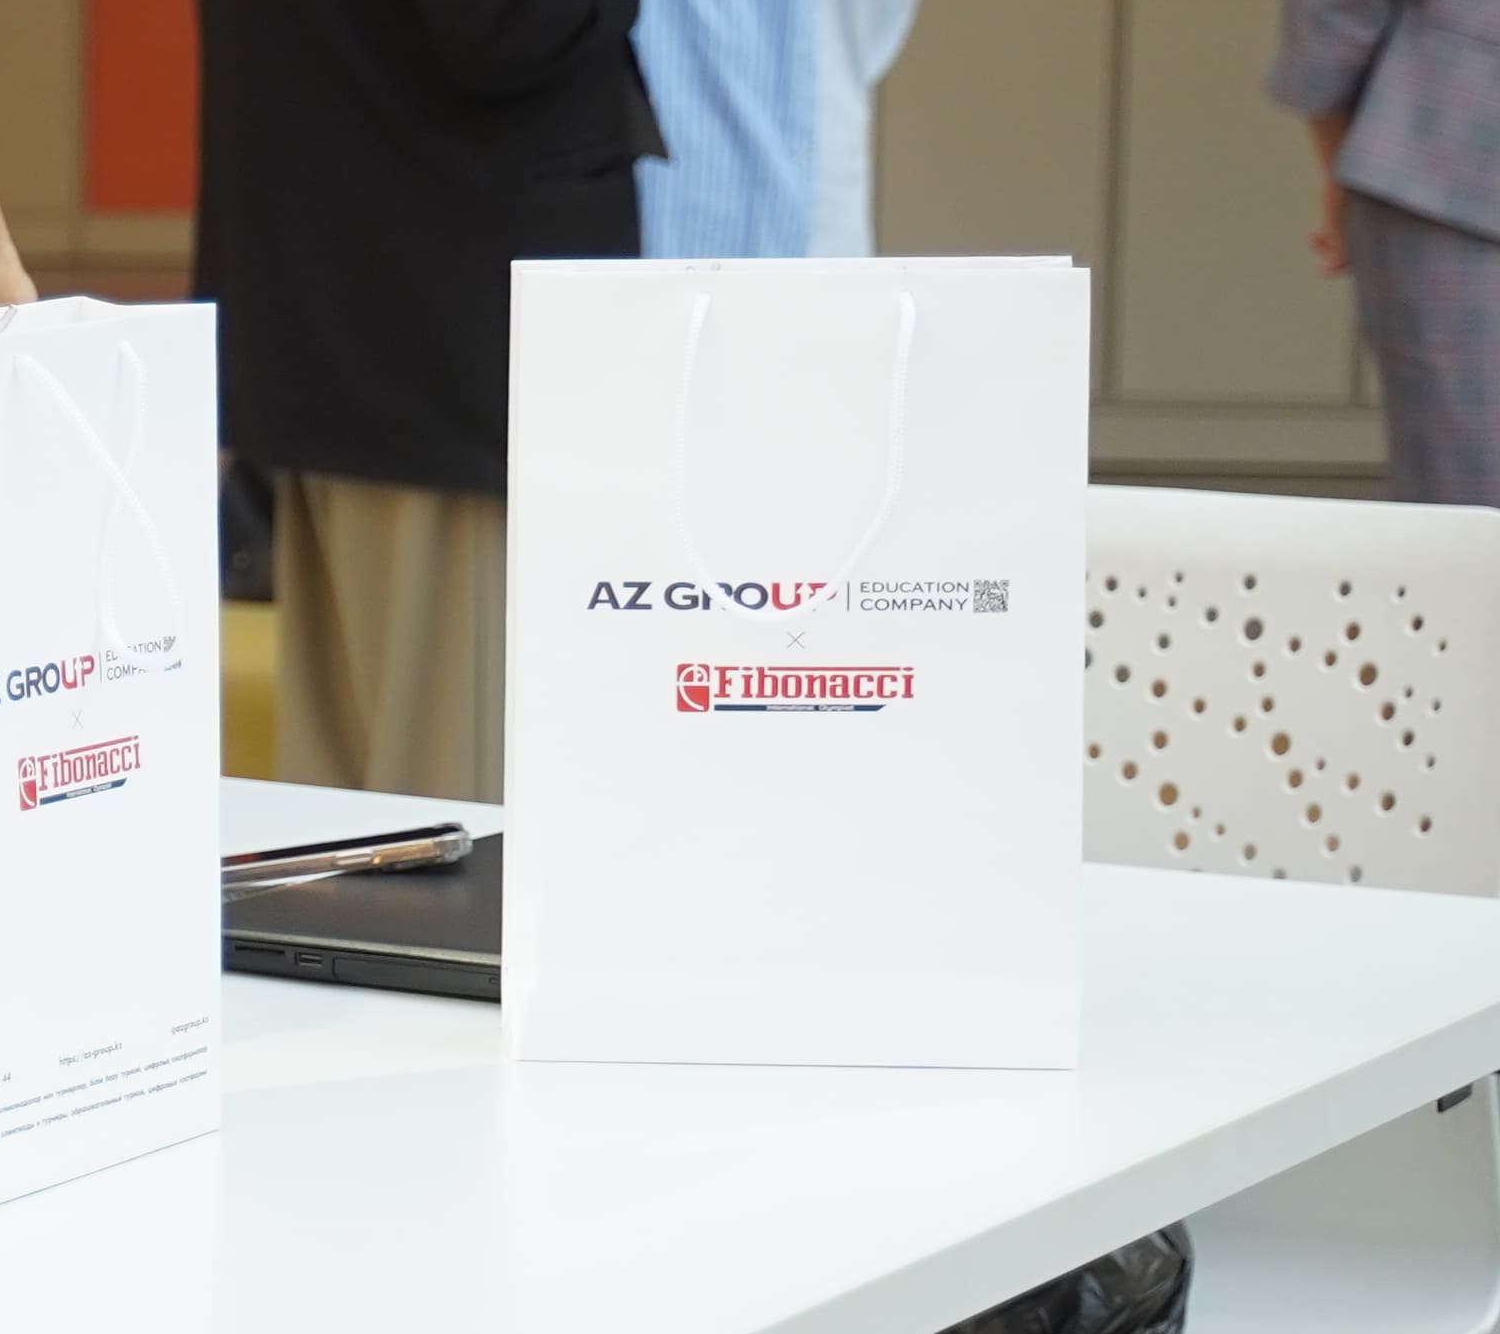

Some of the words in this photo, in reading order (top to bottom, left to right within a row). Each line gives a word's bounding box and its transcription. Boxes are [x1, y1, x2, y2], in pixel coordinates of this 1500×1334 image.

[587, 581, 652, 610] AZ
[860, 581, 970, 594] EDUCATION
[860, 597, 969, 611] COMPANY
[6, 654, 96, 701] GROUP
[713, 666, 915, 699] Fibonacci
[37, 735, 141, 791] Fibonacci
